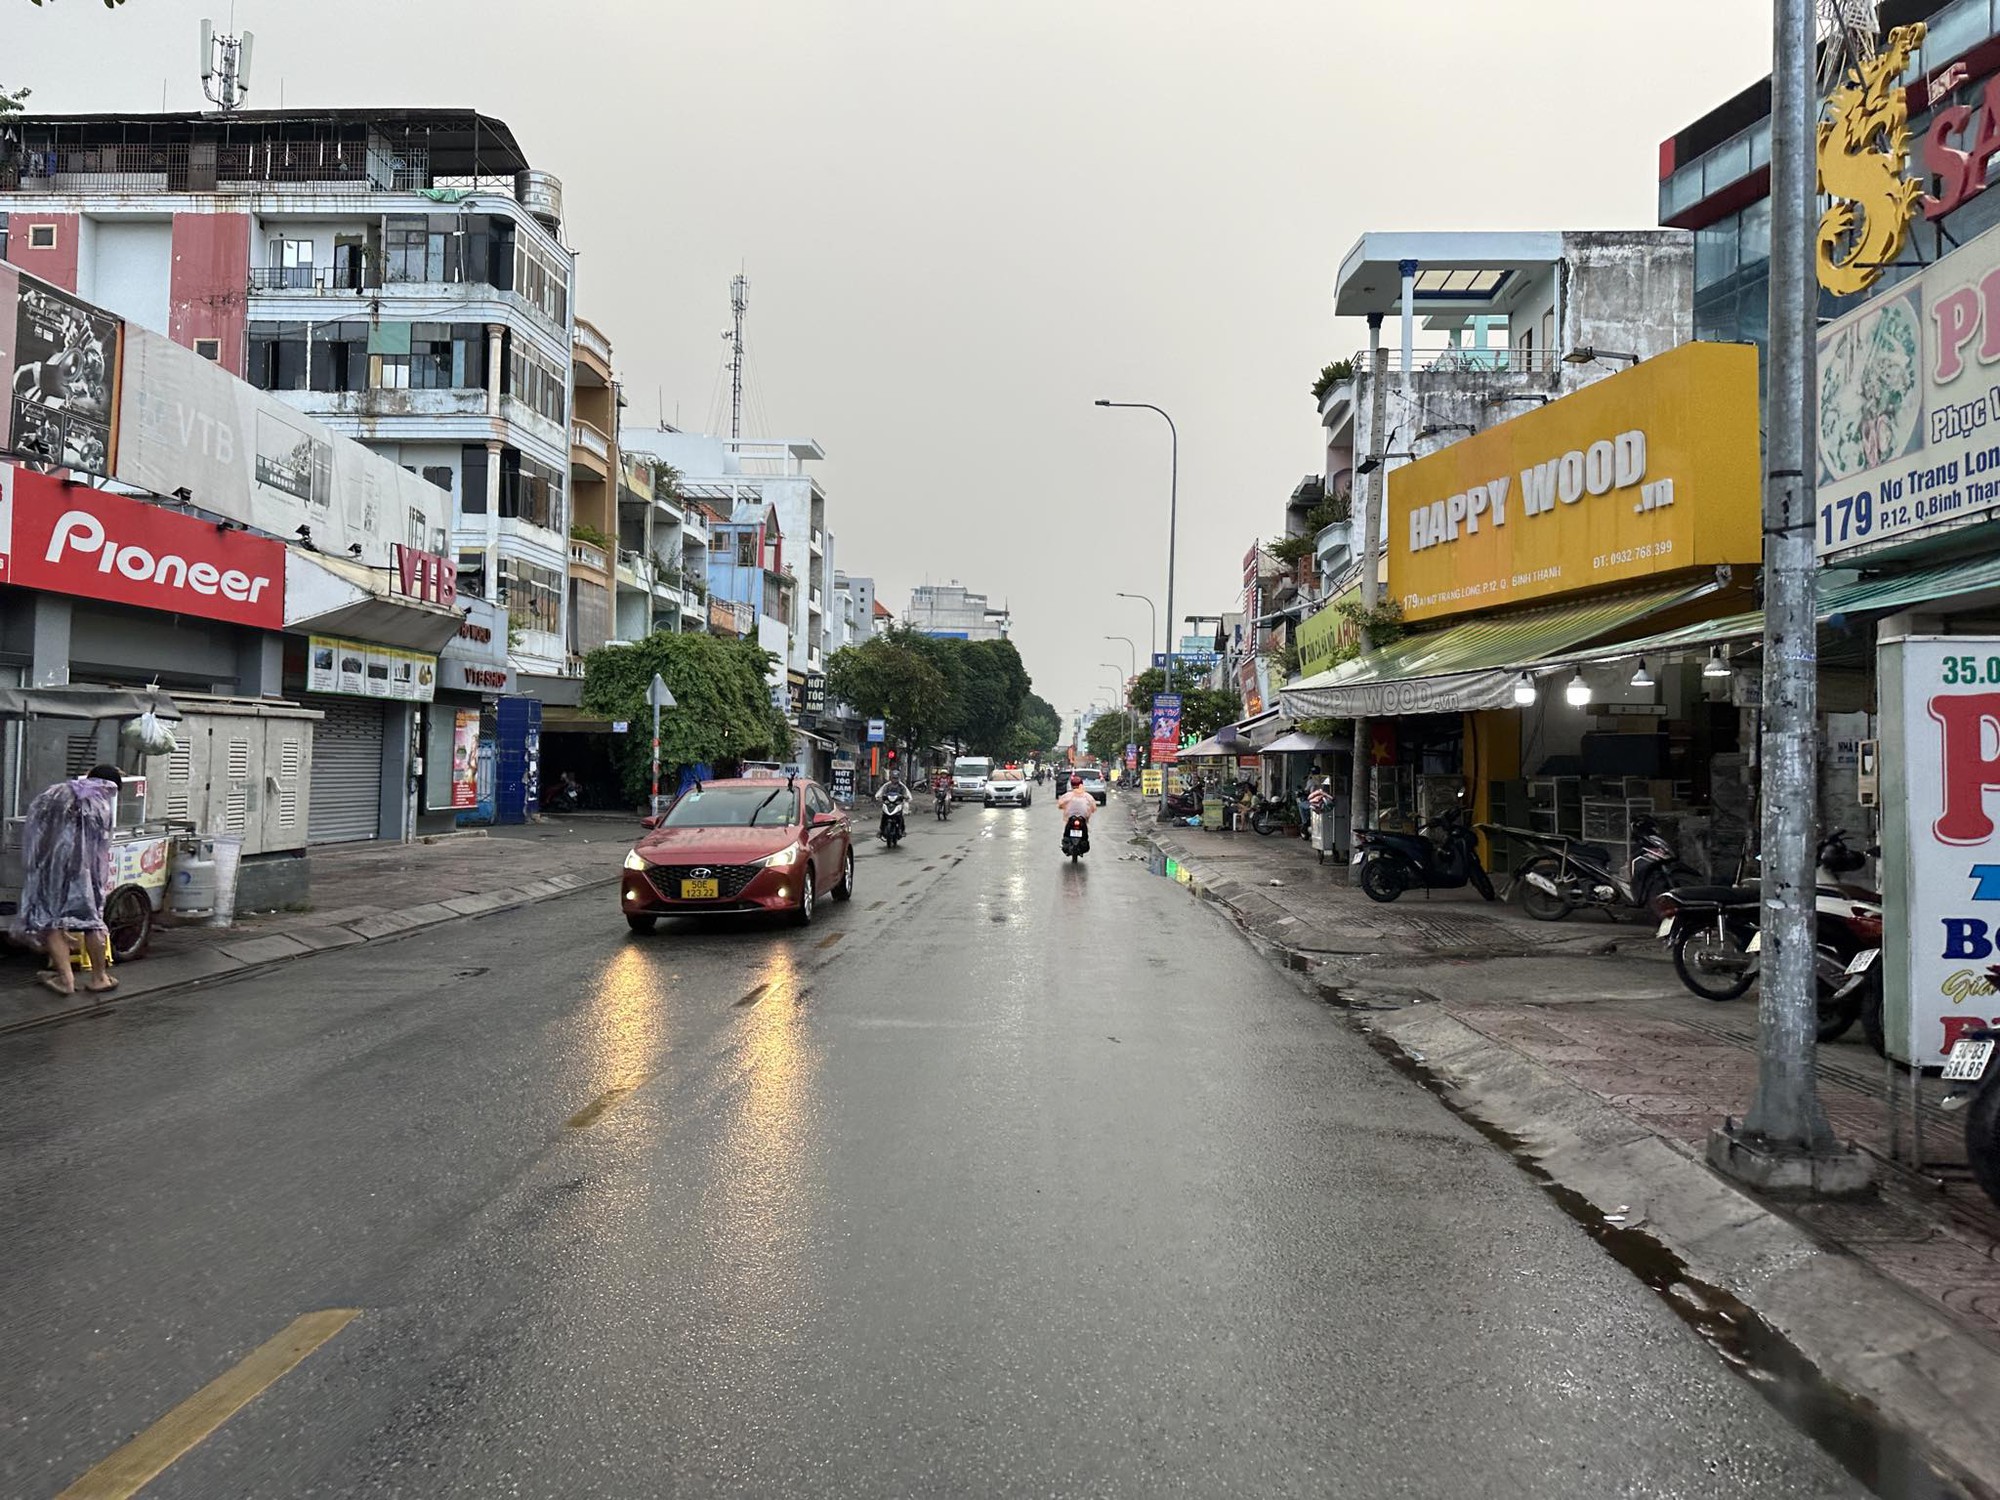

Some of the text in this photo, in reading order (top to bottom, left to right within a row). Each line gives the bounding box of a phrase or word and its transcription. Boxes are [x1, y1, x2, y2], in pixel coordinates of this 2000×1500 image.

[177, 401, 234, 465] VTB
[1932, 397, 1986, 444] Phục
[1409, 476, 1512, 553] HAPPY
[1520, 429, 1647, 517] WOOD
[1821, 491, 1873, 546] 179
[1908, 460, 1959, 494] Trang
[1880, 506, 1911, 530] P.12,
[45, 510, 270, 604] Pioneer
[396, 543, 458, 607] VTB
[806, 702, 824, 711] NAM
[1299, 690, 1357, 715] HAPPY
[1363, 681, 1433, 714] WOOD
